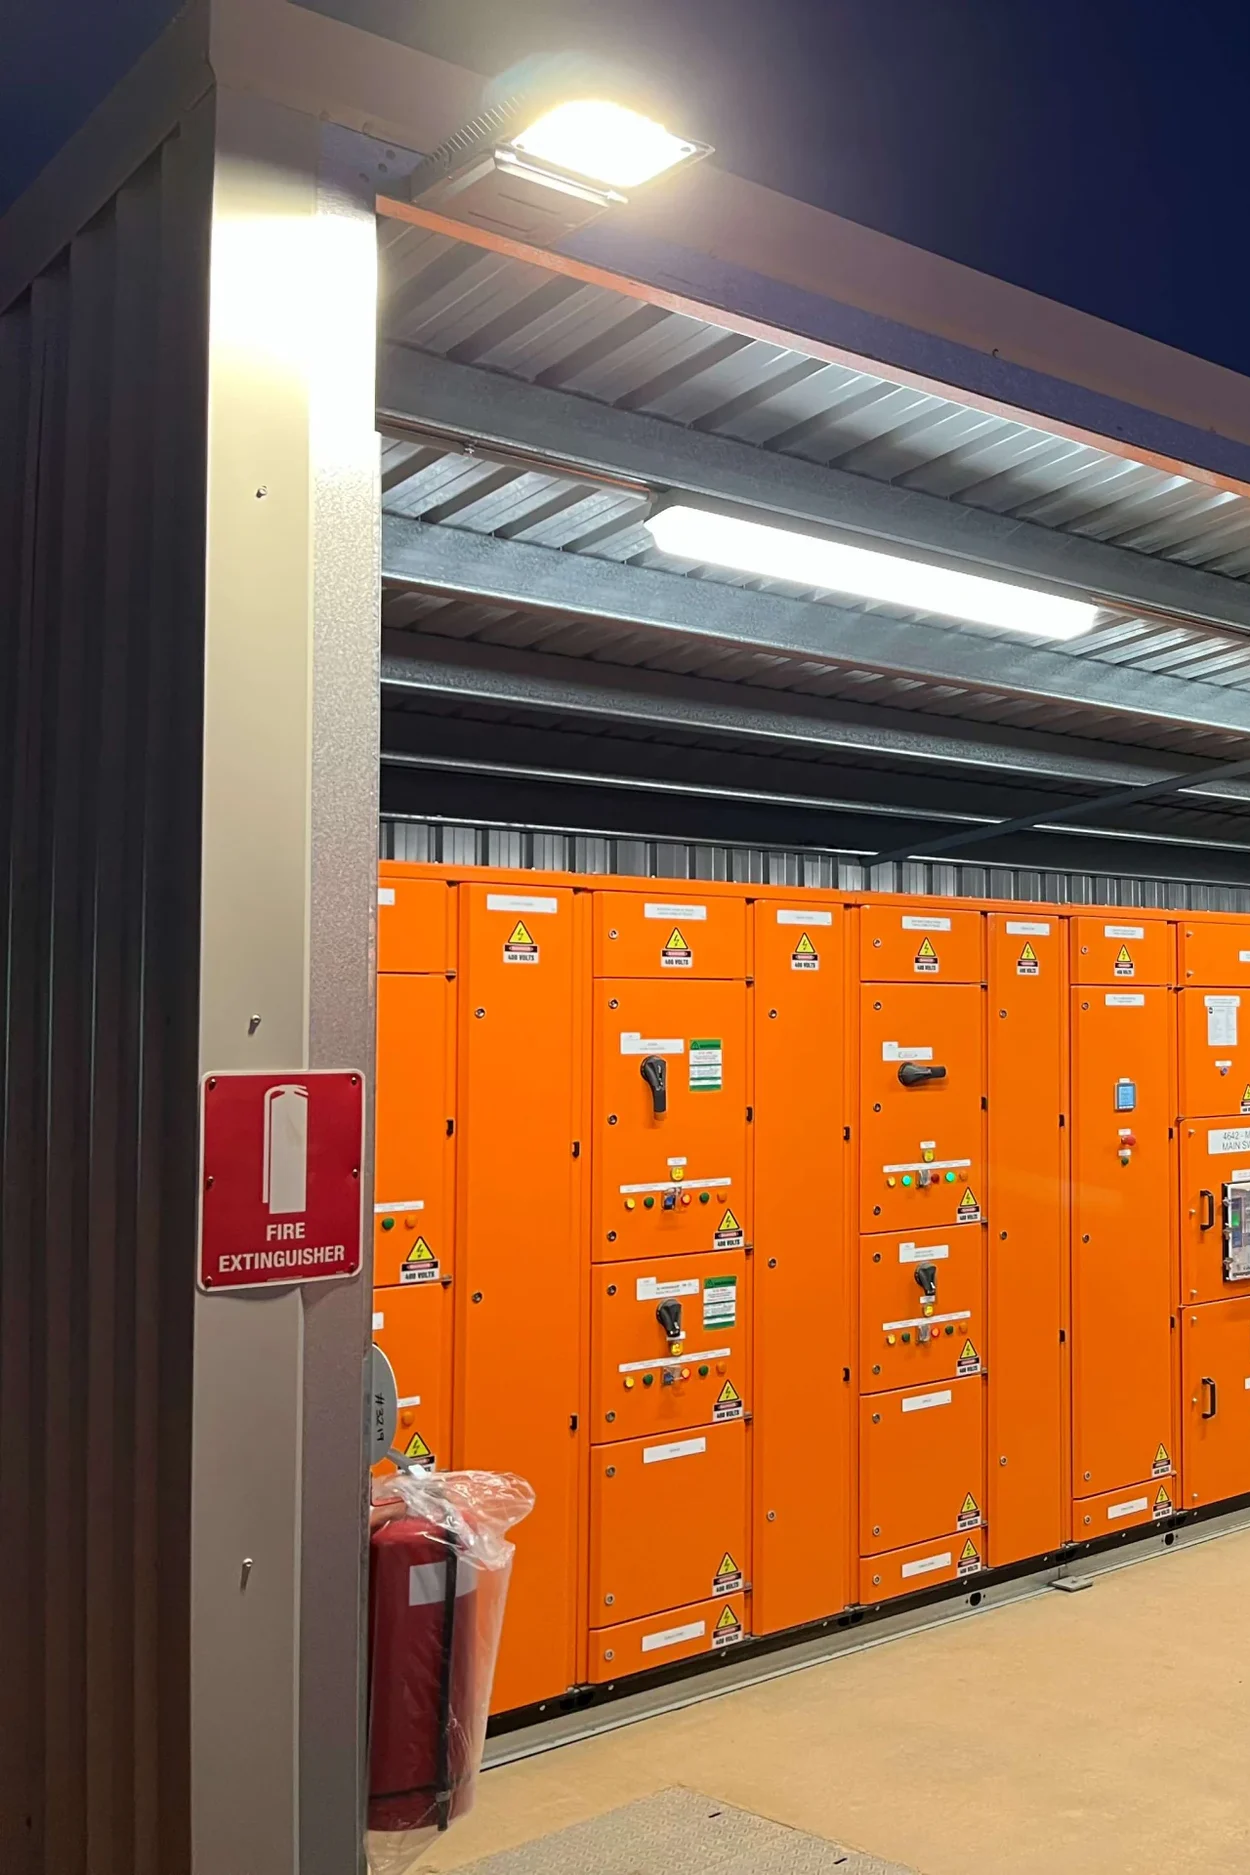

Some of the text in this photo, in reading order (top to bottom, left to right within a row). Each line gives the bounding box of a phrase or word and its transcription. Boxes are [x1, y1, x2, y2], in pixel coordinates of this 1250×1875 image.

[1222, 1141, 1240, 1151] MAIN
[266, 1222, 306, 1242] FIRE
[218, 1244, 345, 1273] EXTINGUISHER
